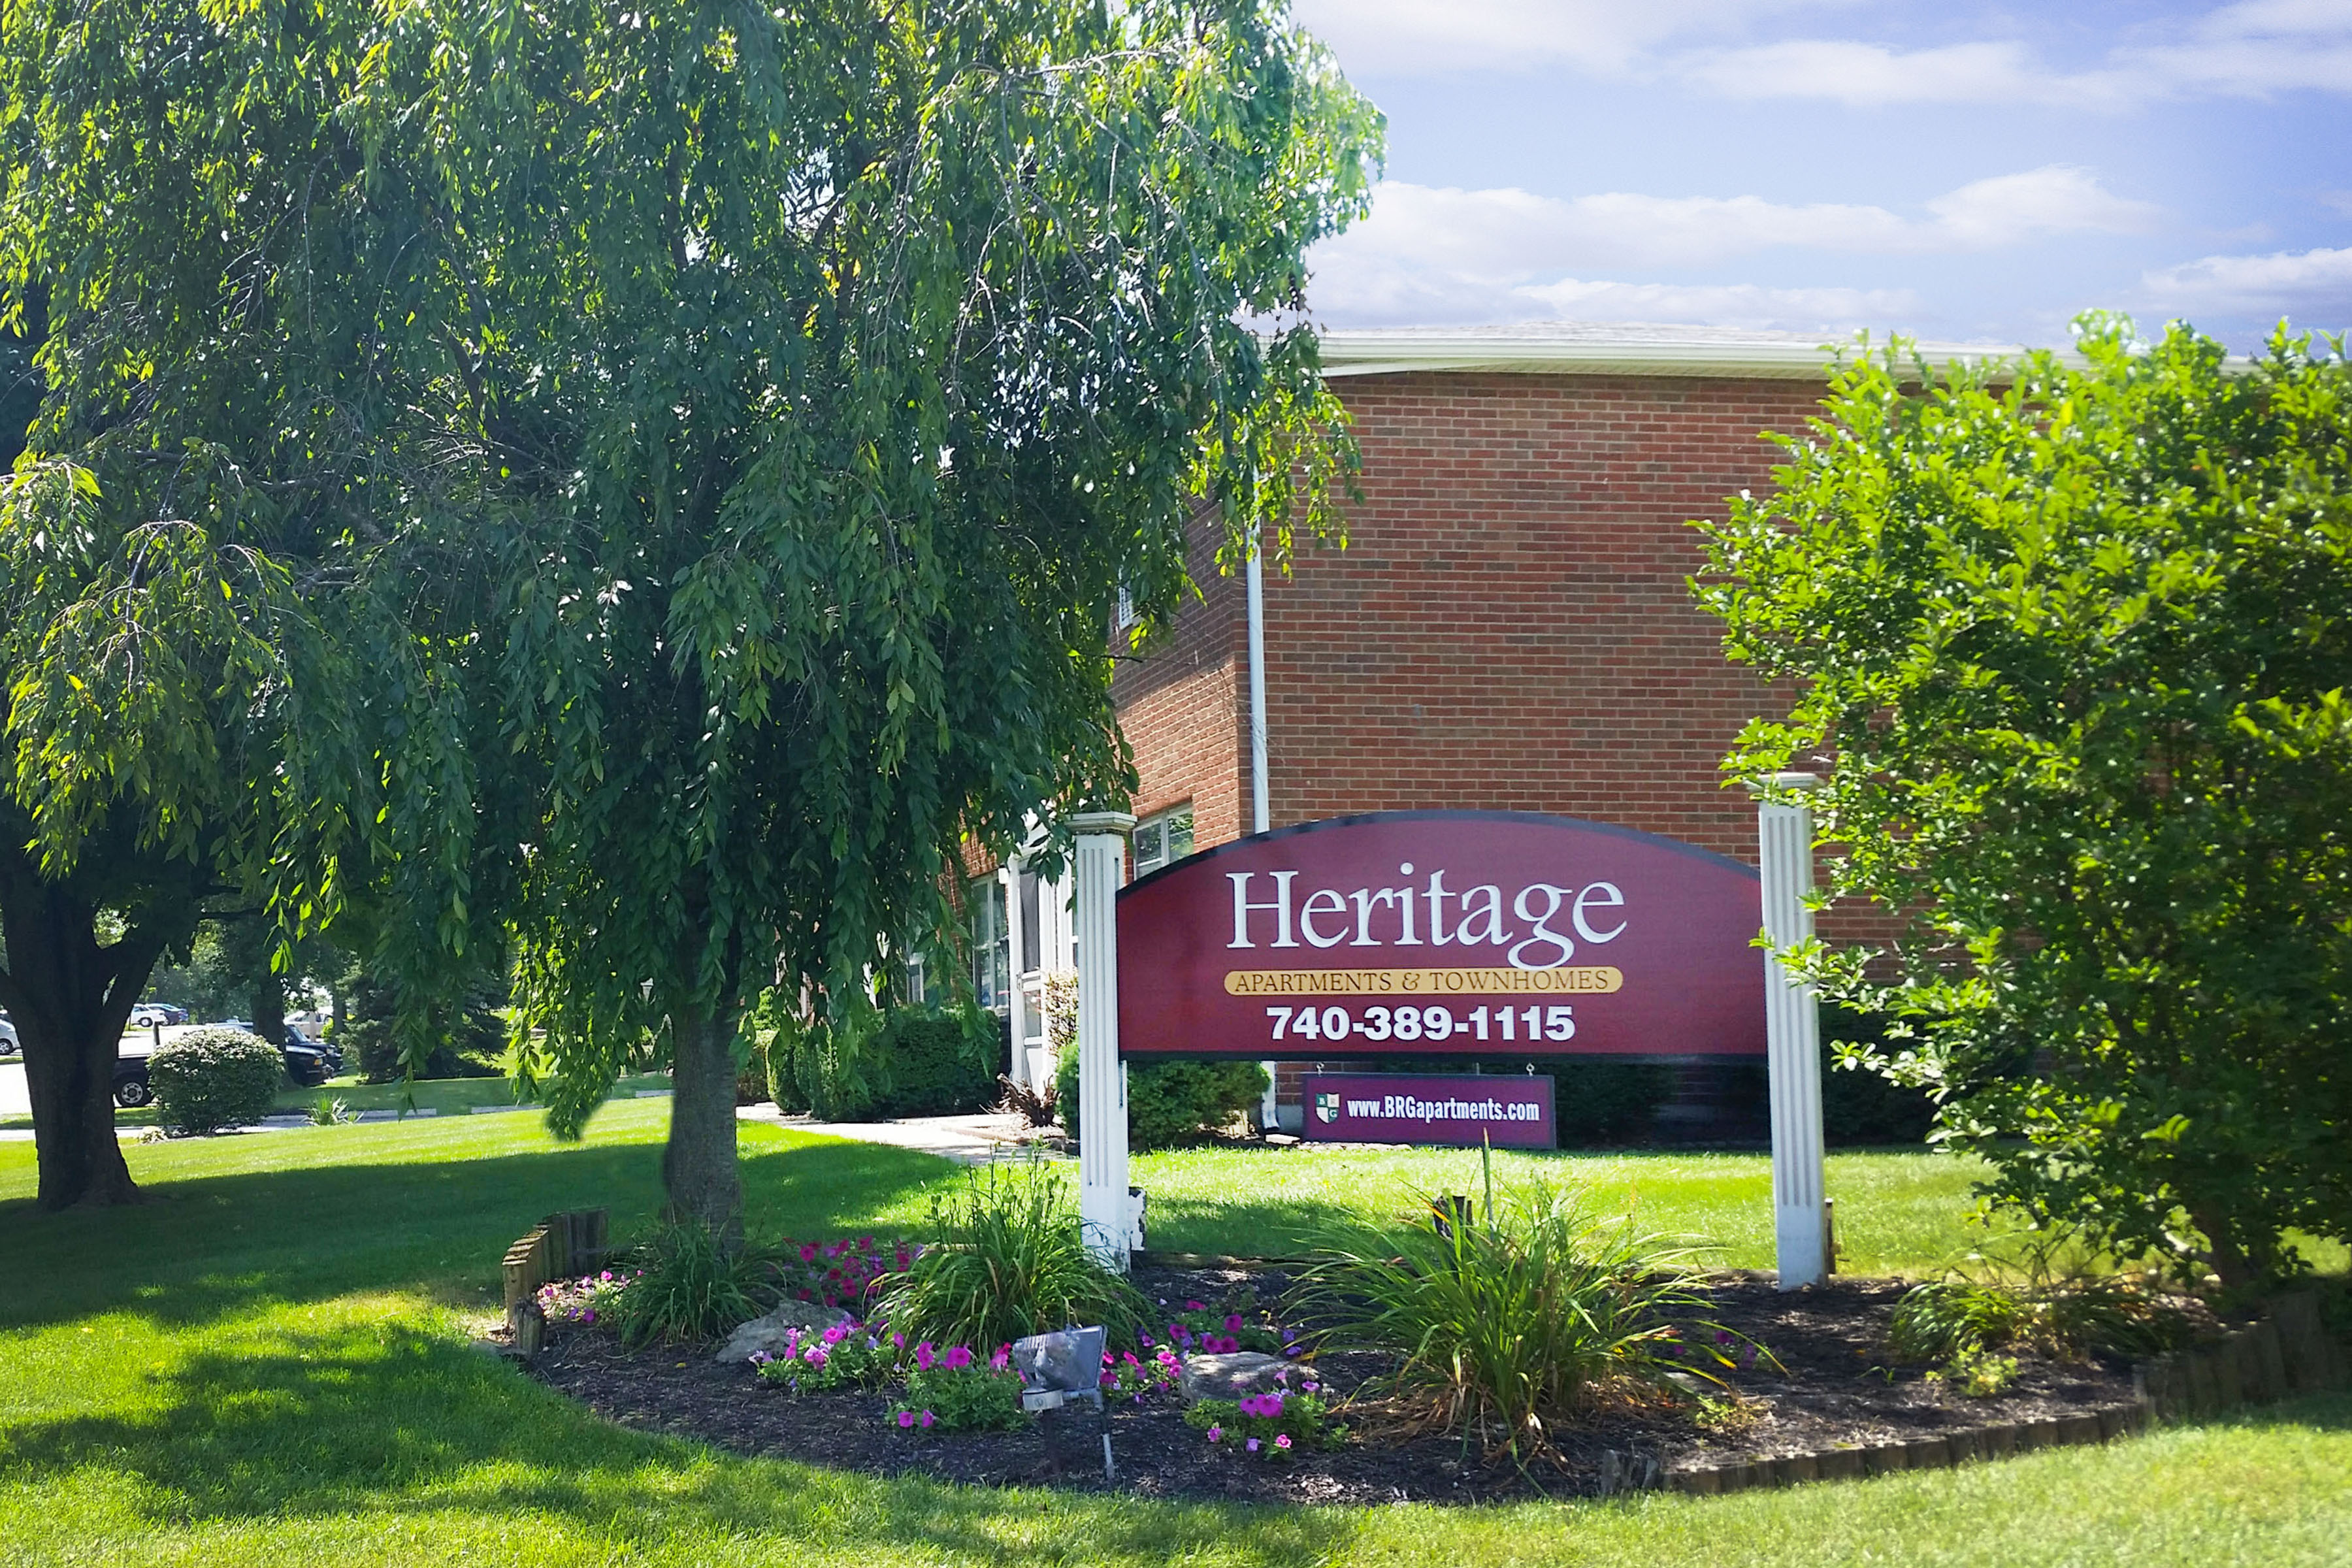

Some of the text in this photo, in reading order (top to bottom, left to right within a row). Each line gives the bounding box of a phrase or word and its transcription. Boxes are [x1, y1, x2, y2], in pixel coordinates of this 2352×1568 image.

[1225, 862, 1627, 970] Heritage
[1235, 970, 1608, 992] APARTMENTS & TOWNHOMES
[1266, 1005, 1575, 1041] 740-389-1115
[1347, 1096, 1540, 1124] www.BRGapartments.com
